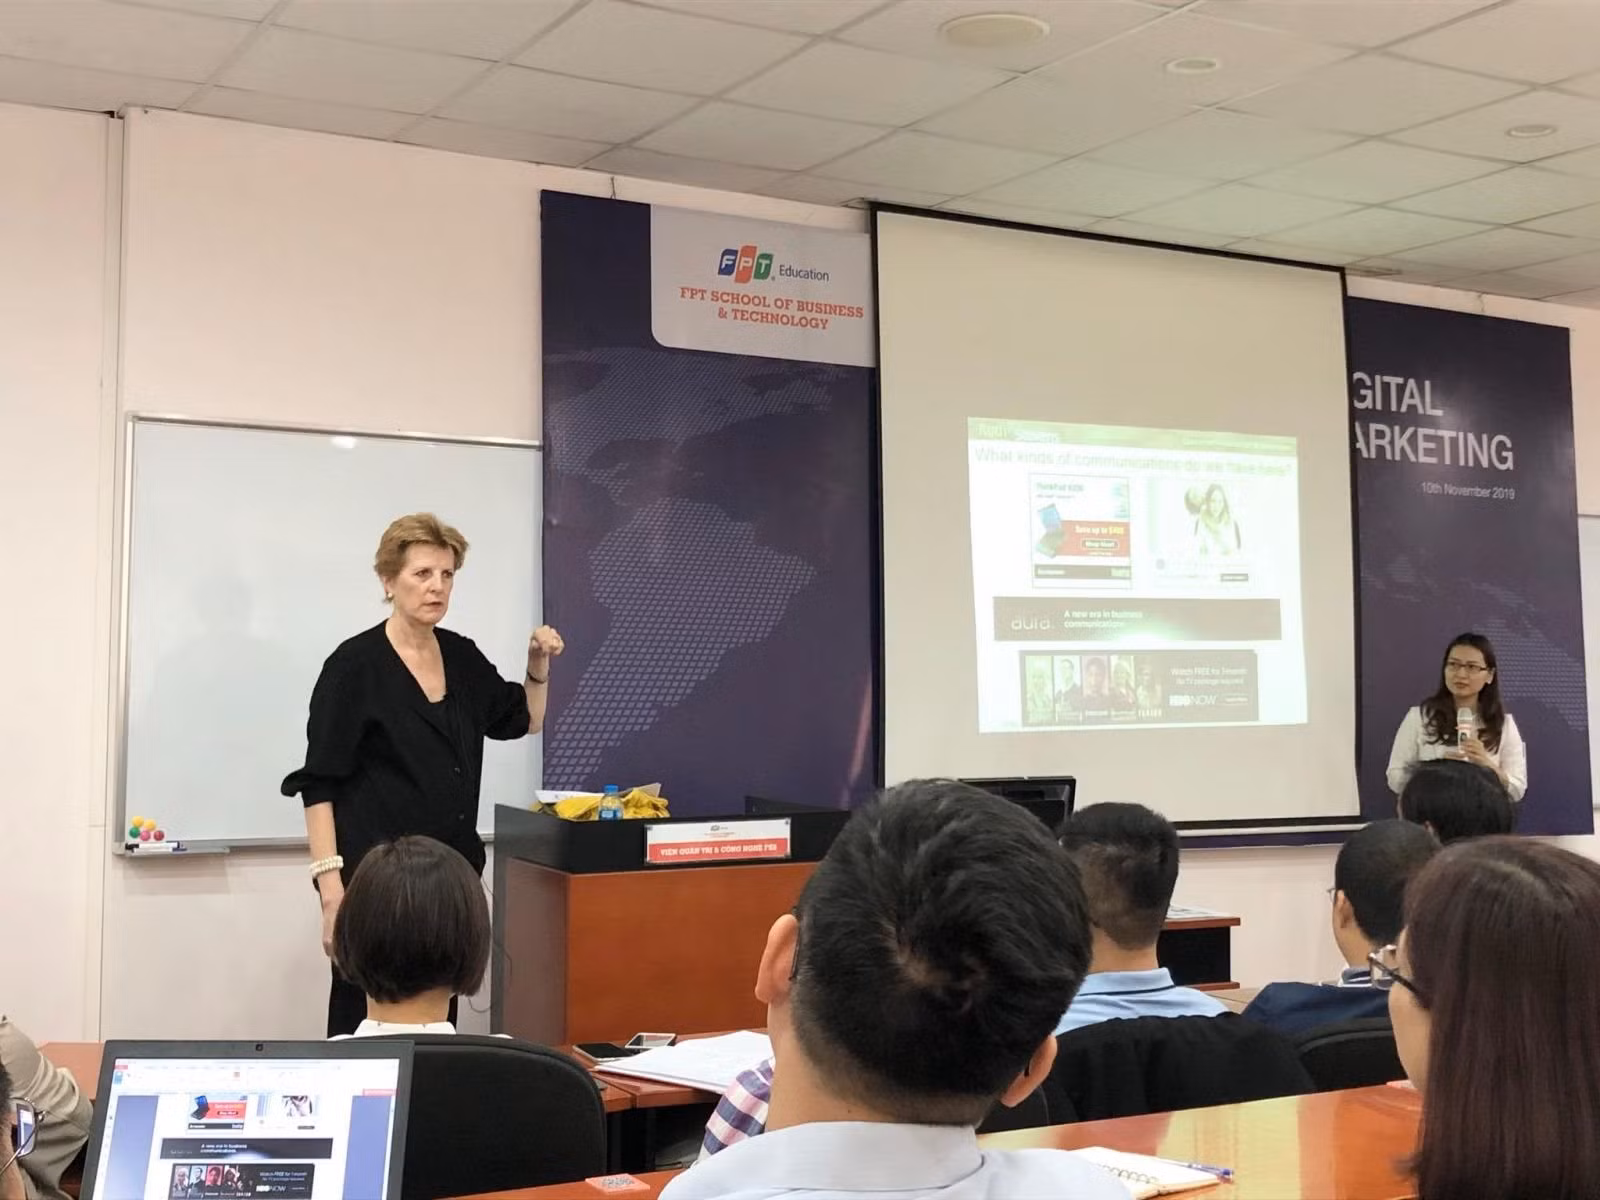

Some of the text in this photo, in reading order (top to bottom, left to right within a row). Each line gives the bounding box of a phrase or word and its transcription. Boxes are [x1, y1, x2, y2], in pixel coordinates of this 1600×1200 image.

[719, 251, 830, 283] FPT Education
[680, 287, 864, 318] FPT SCHOOL OF BUSINESS
[718, 307, 829, 330] & TECHNOLOGY
[1353, 371, 1444, 417] GITAL
[1421, 481, 1516, 500] 10th November 2019
[1064, 610, 1070, 618] A
[1103, 610, 1110, 618] in
